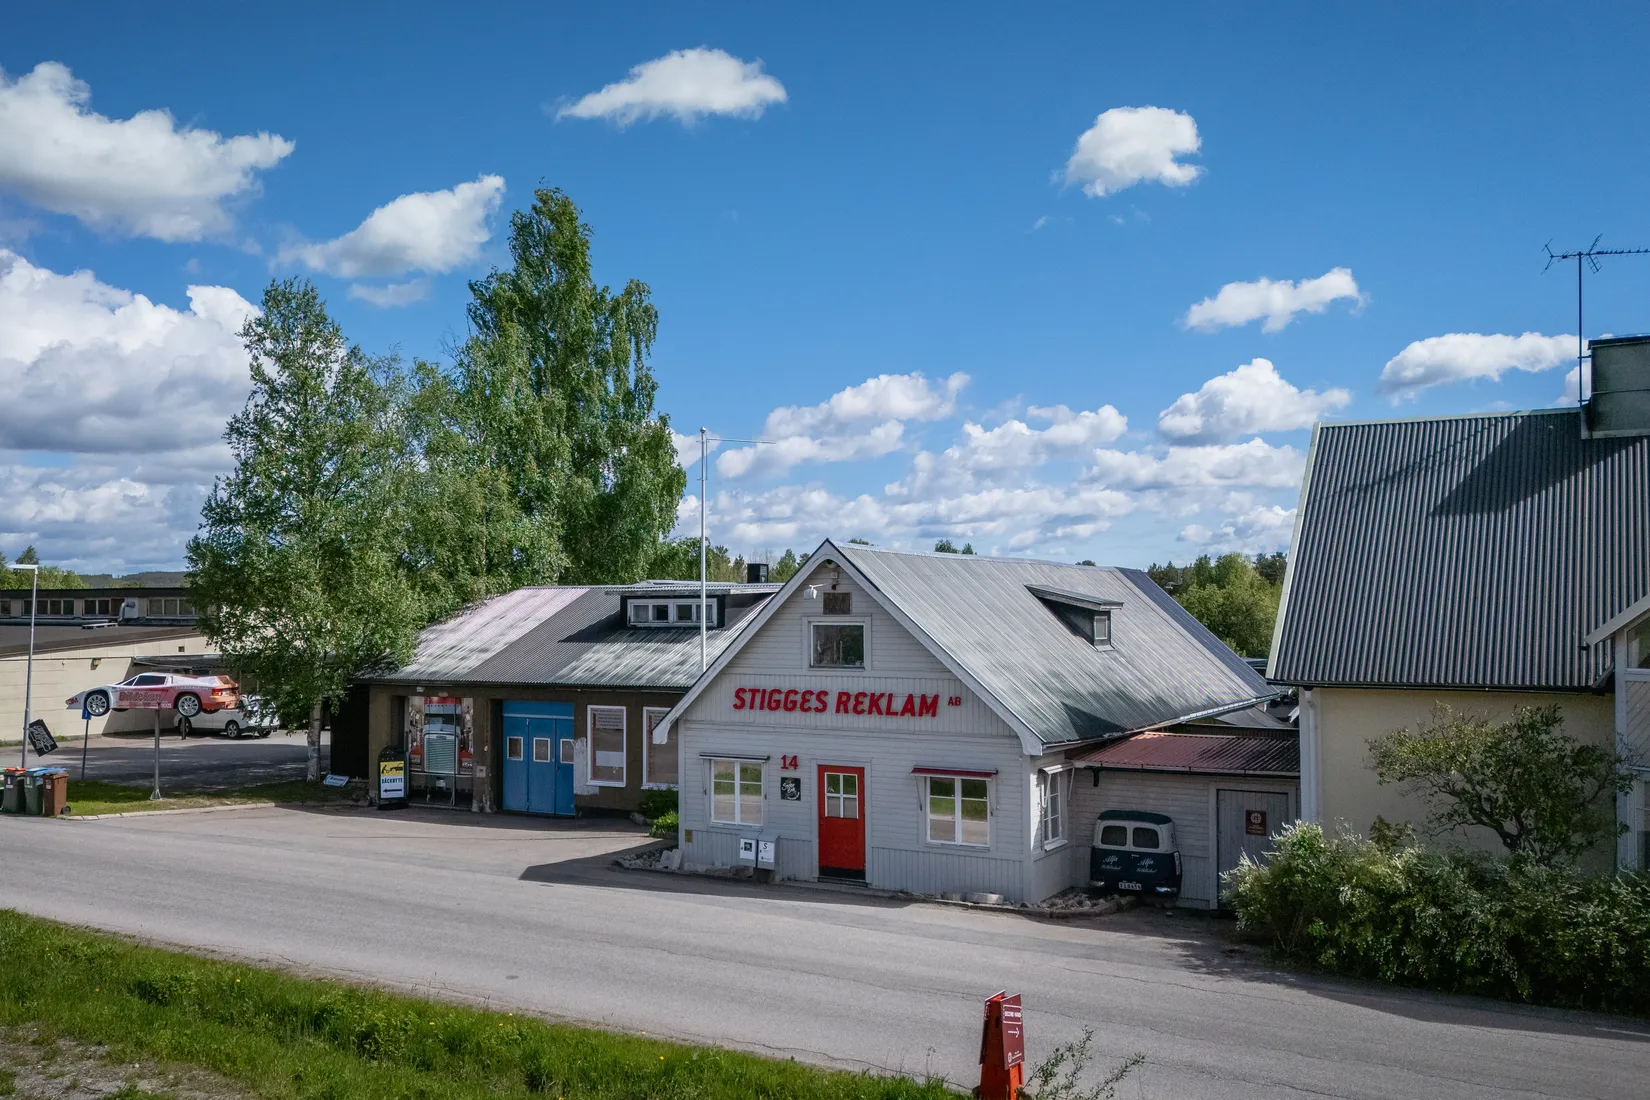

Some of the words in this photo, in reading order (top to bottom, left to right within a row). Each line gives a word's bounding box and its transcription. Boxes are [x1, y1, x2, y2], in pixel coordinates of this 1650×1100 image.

[733, 687, 829, 713] STIGGES
[835, 691, 940, 717] REKLAM
[947, 696, 962, 707] AB
[780, 754, 799, 770] 14
